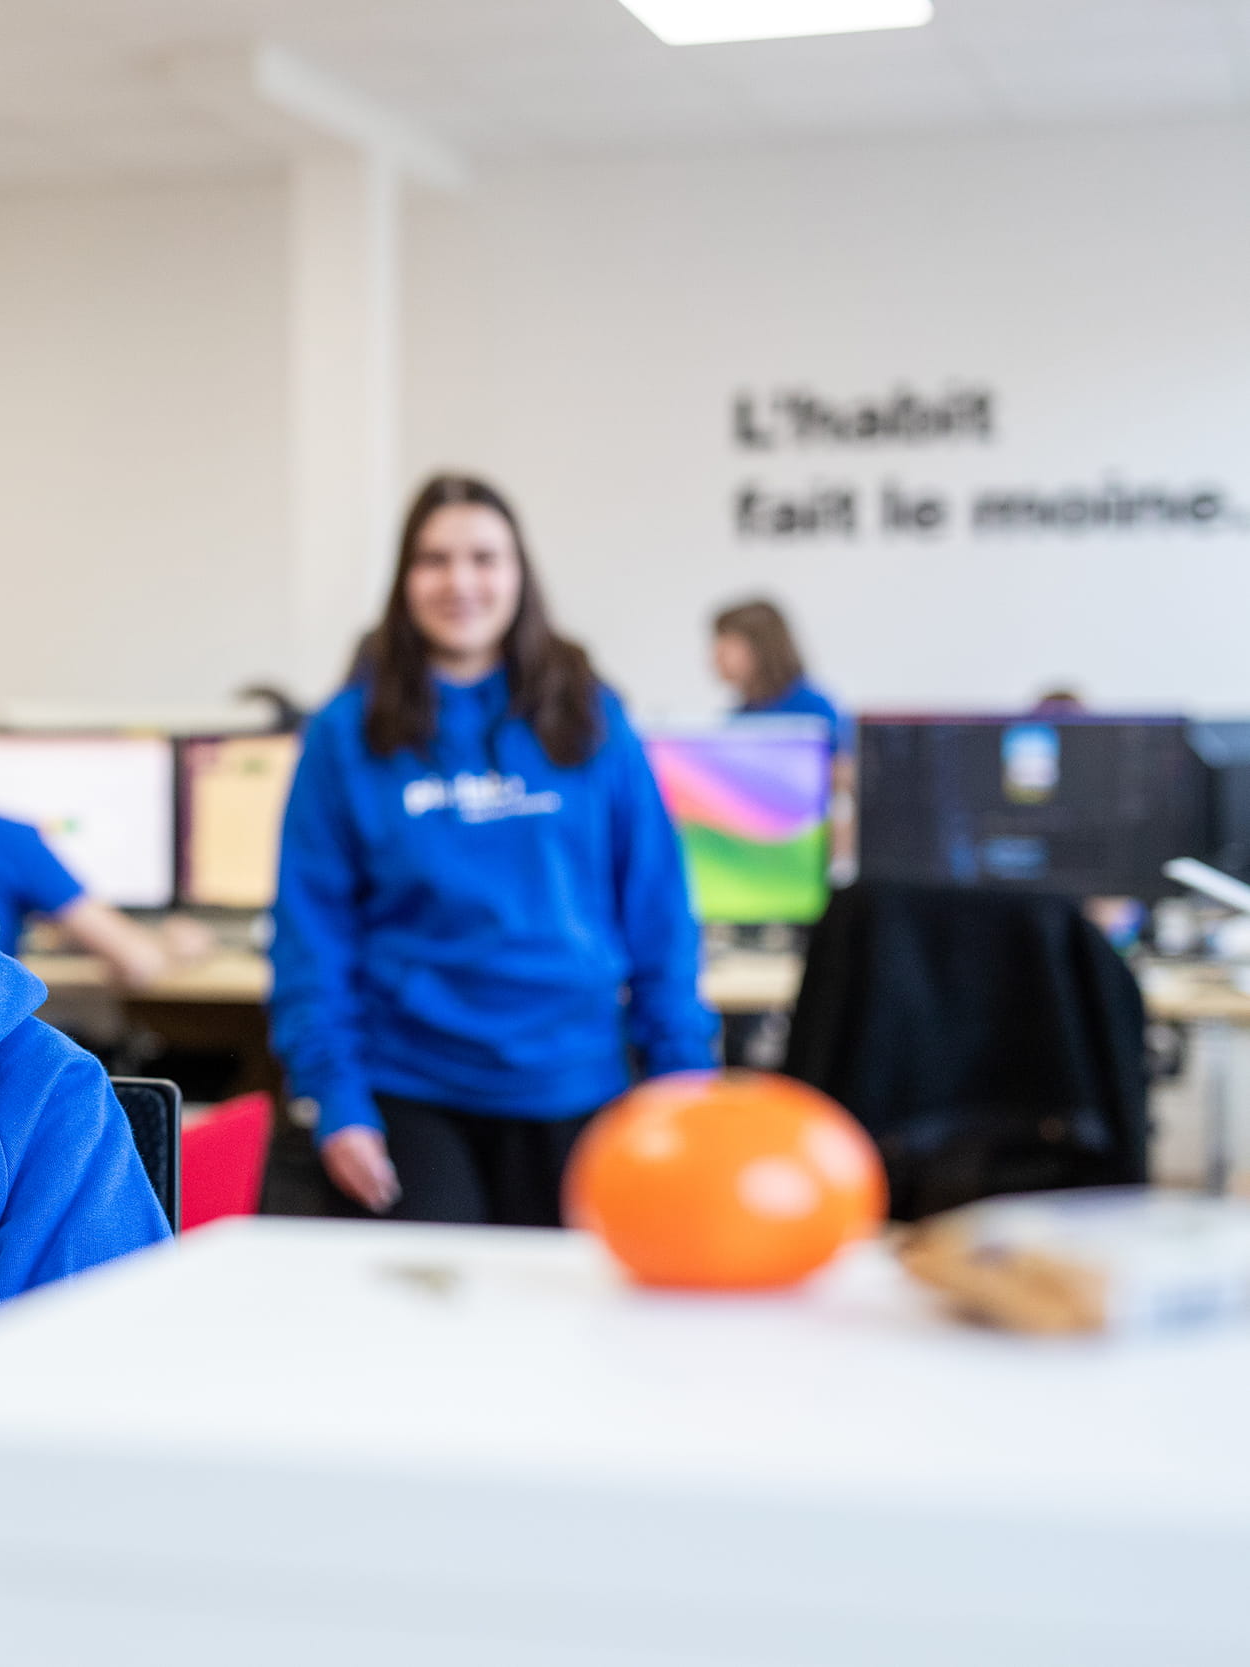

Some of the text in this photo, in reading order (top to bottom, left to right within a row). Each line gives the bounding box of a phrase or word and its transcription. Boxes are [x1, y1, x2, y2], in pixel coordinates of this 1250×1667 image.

[732, 382, 995, 450] L'habit
[734, 480, 858, 538] fait
[881, 480, 945, 536] le
